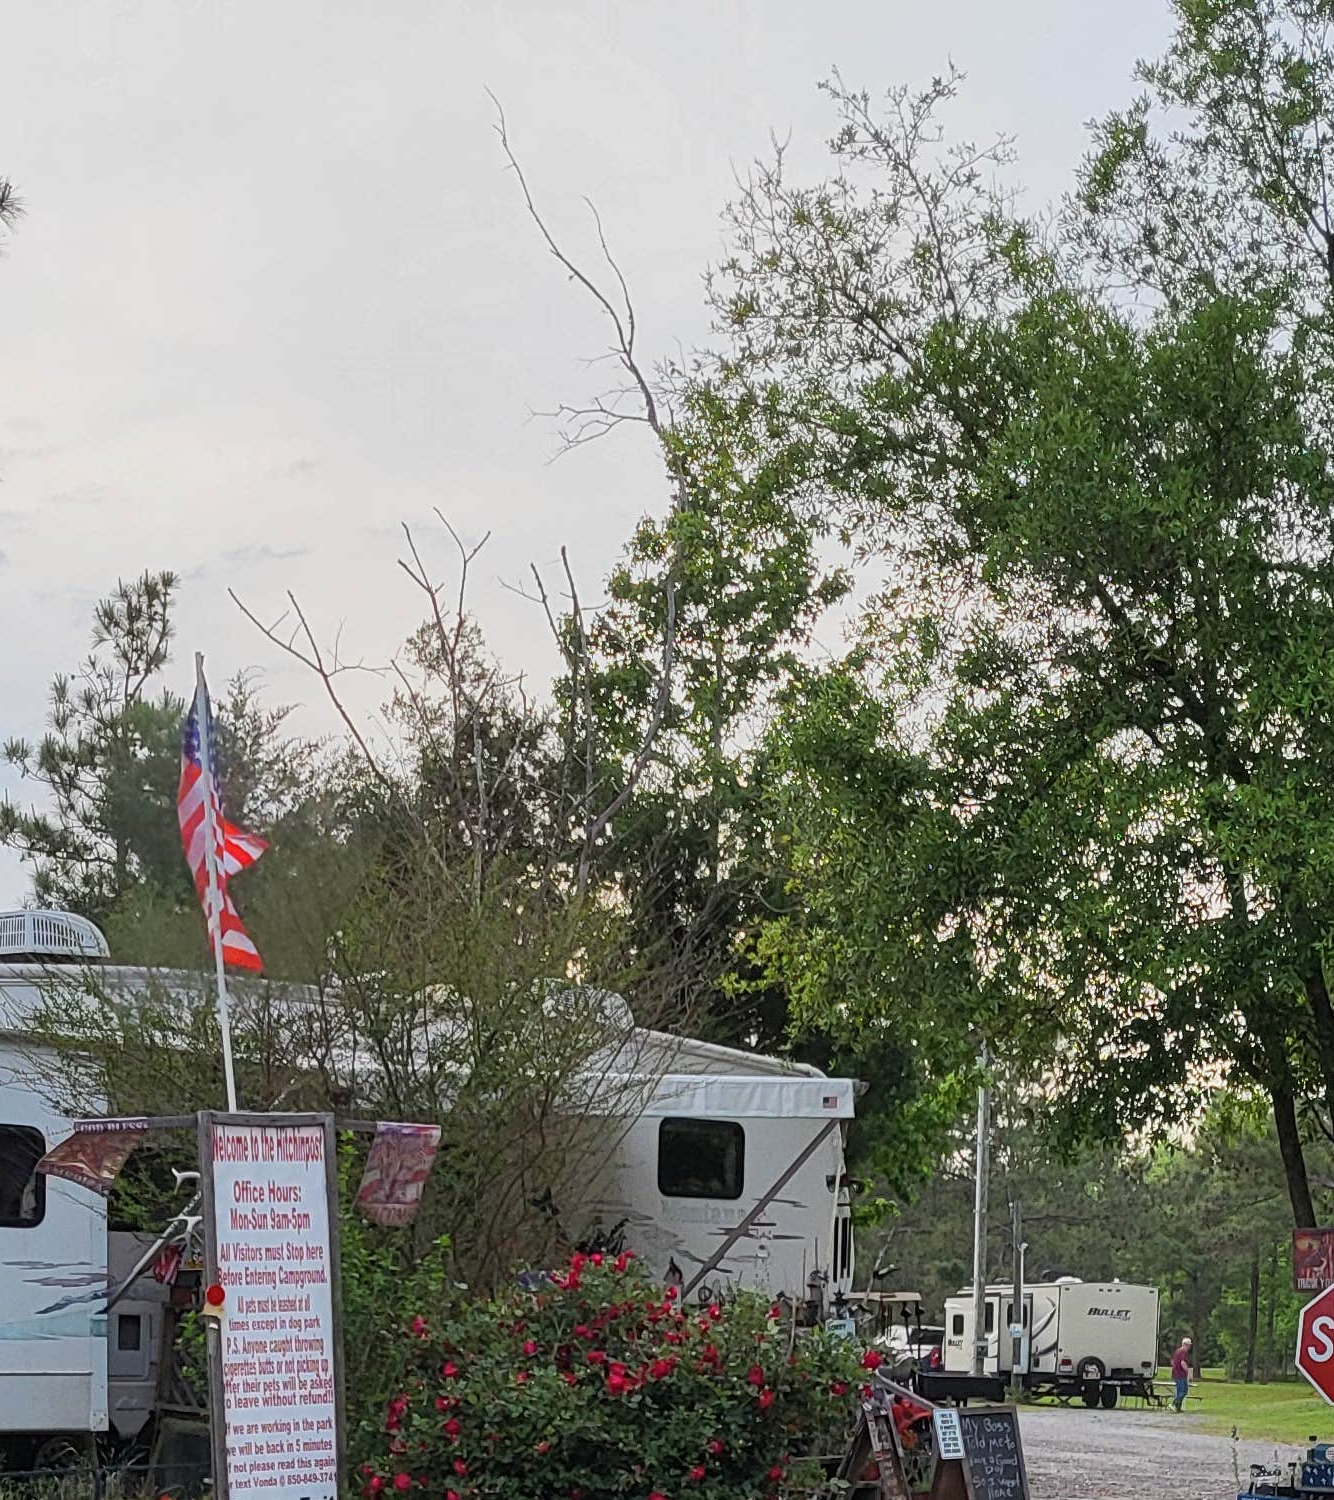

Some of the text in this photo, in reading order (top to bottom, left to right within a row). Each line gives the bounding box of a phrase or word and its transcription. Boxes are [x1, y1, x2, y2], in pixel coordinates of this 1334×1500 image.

[251, 1127, 259, 1162] to
[261, 1127, 274, 1162] the
[233, 1180, 302, 1203] Office Hours:
[230, 1207, 310, 1235] Mon-Sun 9am-5pm
[220, 1242, 323, 1265] All Visitors must Stop here
[218, 1264, 327, 1290] Before Entering Campground.
[1087, 1307, 1131, 1317] BULLET
[228, 1315, 321, 1333] times except in dog park
[226, 1333, 324, 1358] P.S. Anyone caught throwing
[276, 1360, 284, 1374] or
[285, 1358, 295, 1374] not
[297, 1355, 319, 1378] picking
[321, 1358, 328, 1377] up
[242, 1377, 261, 1393] their
[263, 1377, 280, 1395] pets
[282, 1376, 296, 1391] will
[298, 1376, 308, 1390] be
[310, 1374, 332, 1389] asked
[235, 1394, 259, 1409] leave
[262, 1392, 297, 1407] without
[233, 1424, 244, 1435] we
[246, 1423, 259, 1434] are
[261, 1419, 291, 1435] working
[293, 1418, 300, 1431] in
[302, 1419, 314, 1431] the
[316, 1417, 333, 1434] park
[983, 1417, 1011, 1432] Boss
[238, 1442, 252, 1456] will
[254, 1441, 264, 1455] be
[266, 1440, 285, 1454] back
[286, 1439, 294, 1453] in
[296, 1439, 301, 1452] 5
[303, 1438, 332, 1451] minutes
[234, 1461, 247, 1473] not
[249, 1459, 275, 1474] please
[277, 1457, 295, 1470] read
[297, 1456, 312, 1470] this
[314, 1455, 335, 1470] again
[235, 1477, 251, 1489] text
[253, 1475, 277, 1488] Vonda
